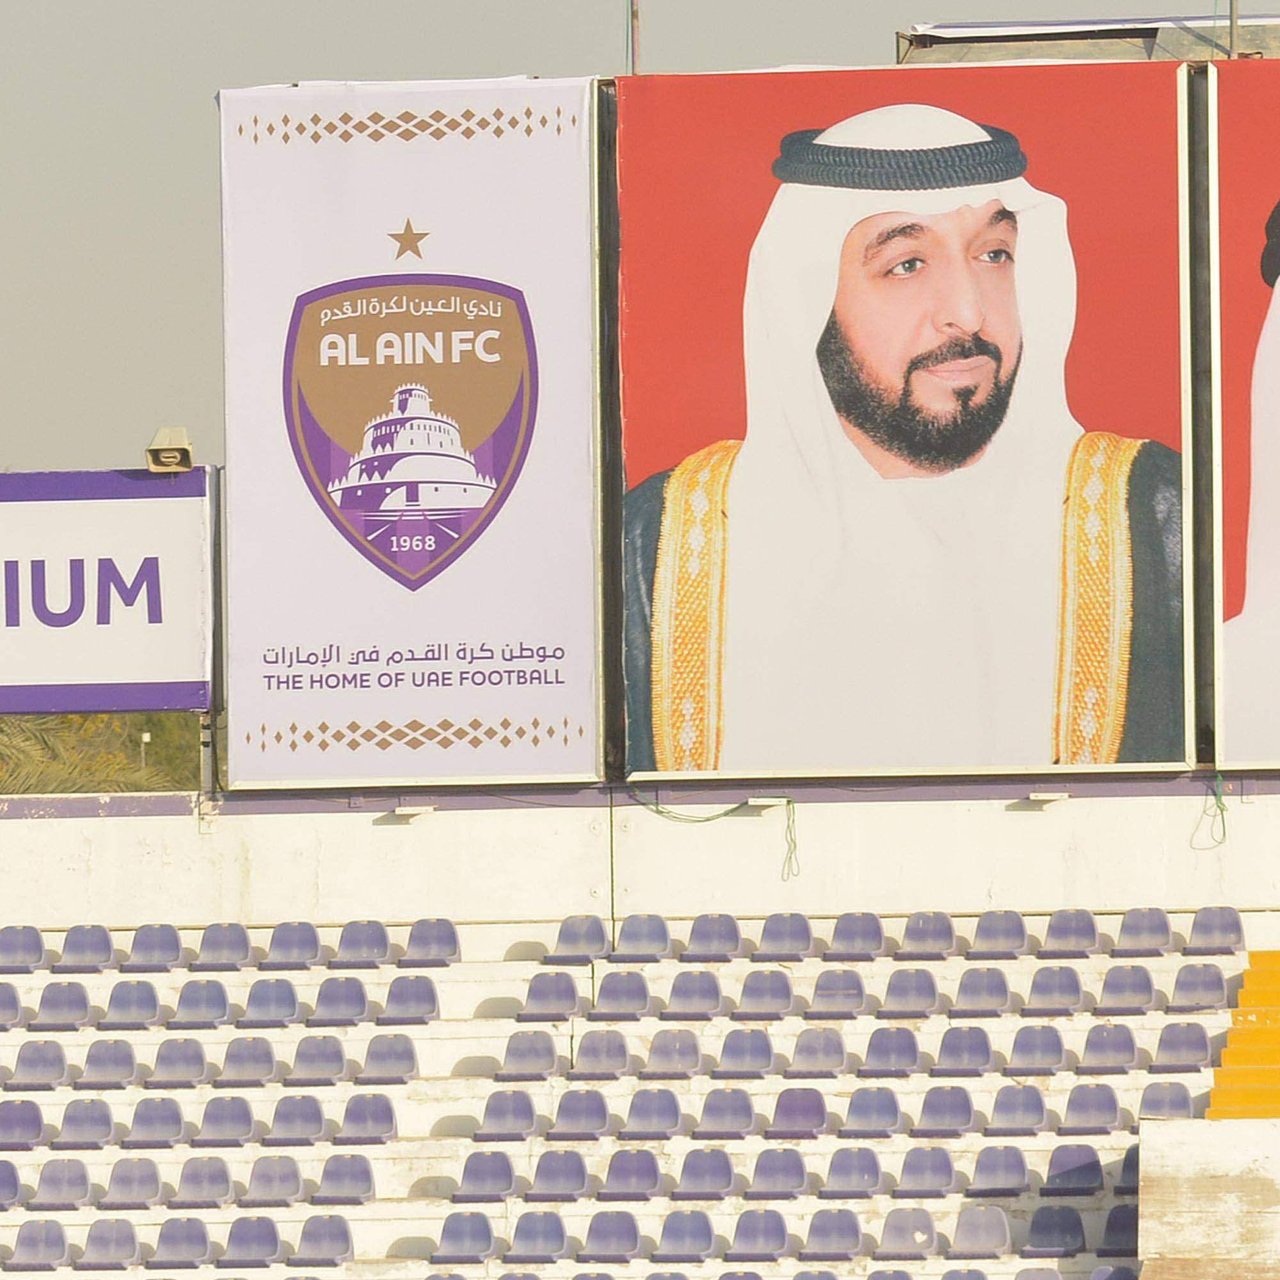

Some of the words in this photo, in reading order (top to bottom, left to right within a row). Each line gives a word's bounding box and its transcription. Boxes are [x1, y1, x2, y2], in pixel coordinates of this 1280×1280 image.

[320, 299, 367, 327] القدم
[369, 295, 407, 318] لكرة
[409, 296, 460, 316] العين
[463, 299, 502, 320] نادي
[320, 333, 369, 366] AL
[376, 331, 443, 365] AIN
[451, 330, 501, 363] FC
[390, 535, 436, 551] 1968
[263, 644, 340, 668] الإمارات
[386, 644, 449, 667] القدم
[456, 643, 494, 665] كرة
[501, 642, 565, 663] موطن
[263, 674, 303, 691] THE
[310, 672, 371, 689] HOME
[377, 672, 405, 688] OF
[412, 671, 453, 688] UAE
[459, 669, 565, 687] FOOTBALL
